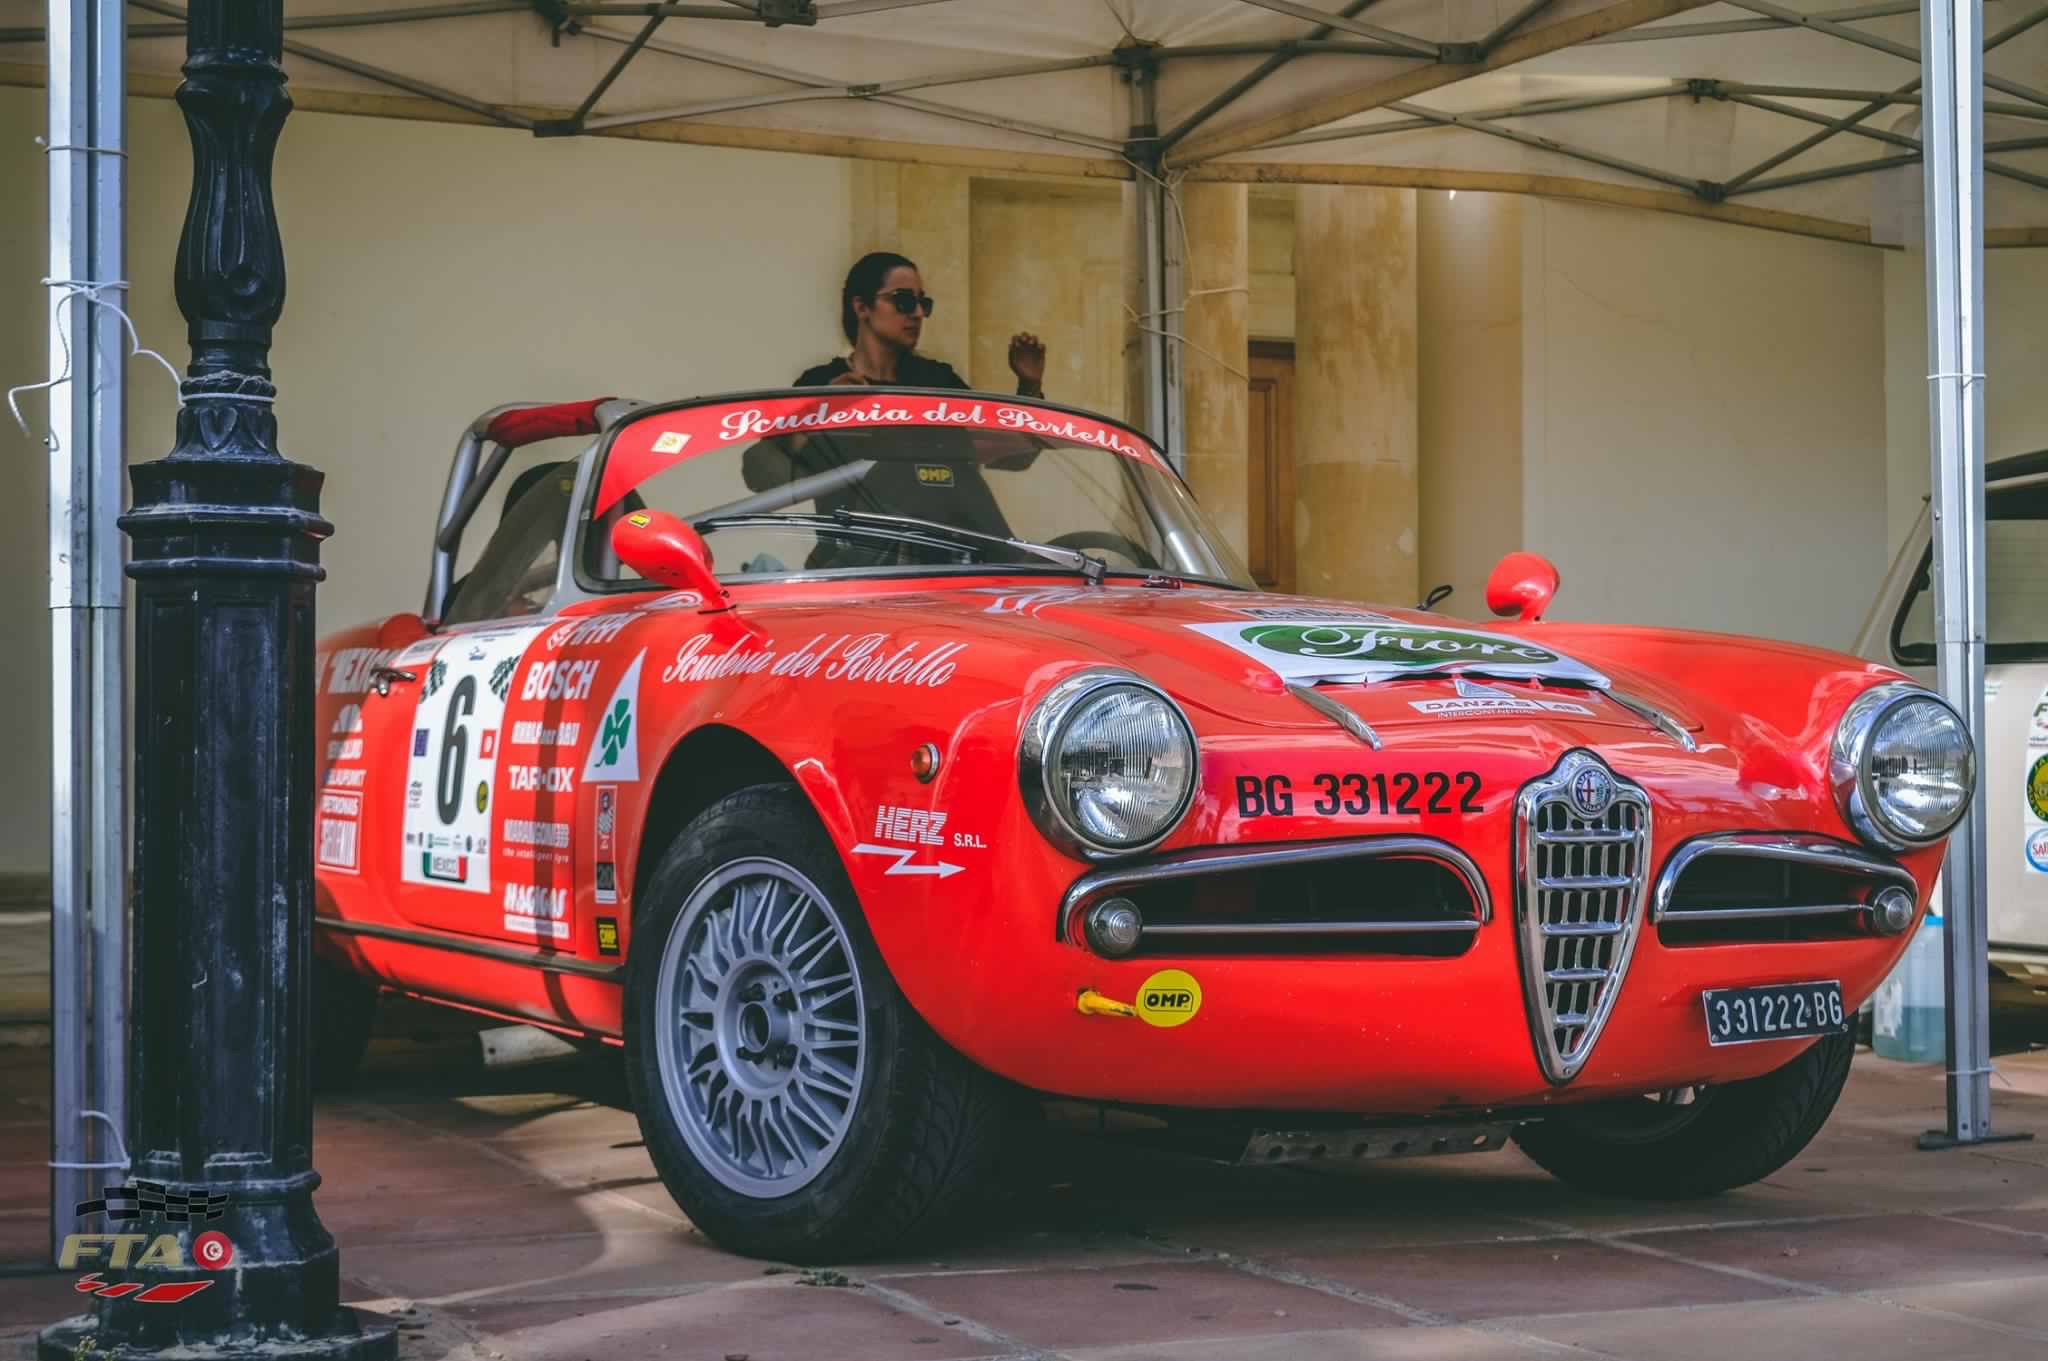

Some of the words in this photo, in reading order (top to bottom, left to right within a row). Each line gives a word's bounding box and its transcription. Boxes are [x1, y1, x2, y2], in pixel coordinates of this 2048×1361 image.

[719, 402, 913, 440] Scuderia
[922, 402, 986, 424] del
[996, 407, 1141, 457] Portello
[918, 467, 951, 482] OMP
[521, 660, 600, 701] BOSCH
[663, 633, 782, 683] Scuderia
[770, 633, 827, 678] del
[825, 633, 968, 687] Portello
[1425, 699, 1531, 711] DANZAS
[436, 674, 478, 825] 6
[1235, 775, 1294, 818] BG
[1313, 771, 1485, 816] 331222
[874, 804, 948, 846] HERZ
[953, 832, 988, 849] S.R.L.
[1145, 993, 1191, 1008] OMP
[1715, 992, 1808, 1036] 331222
[1812, 990, 1843, 1027] BG
